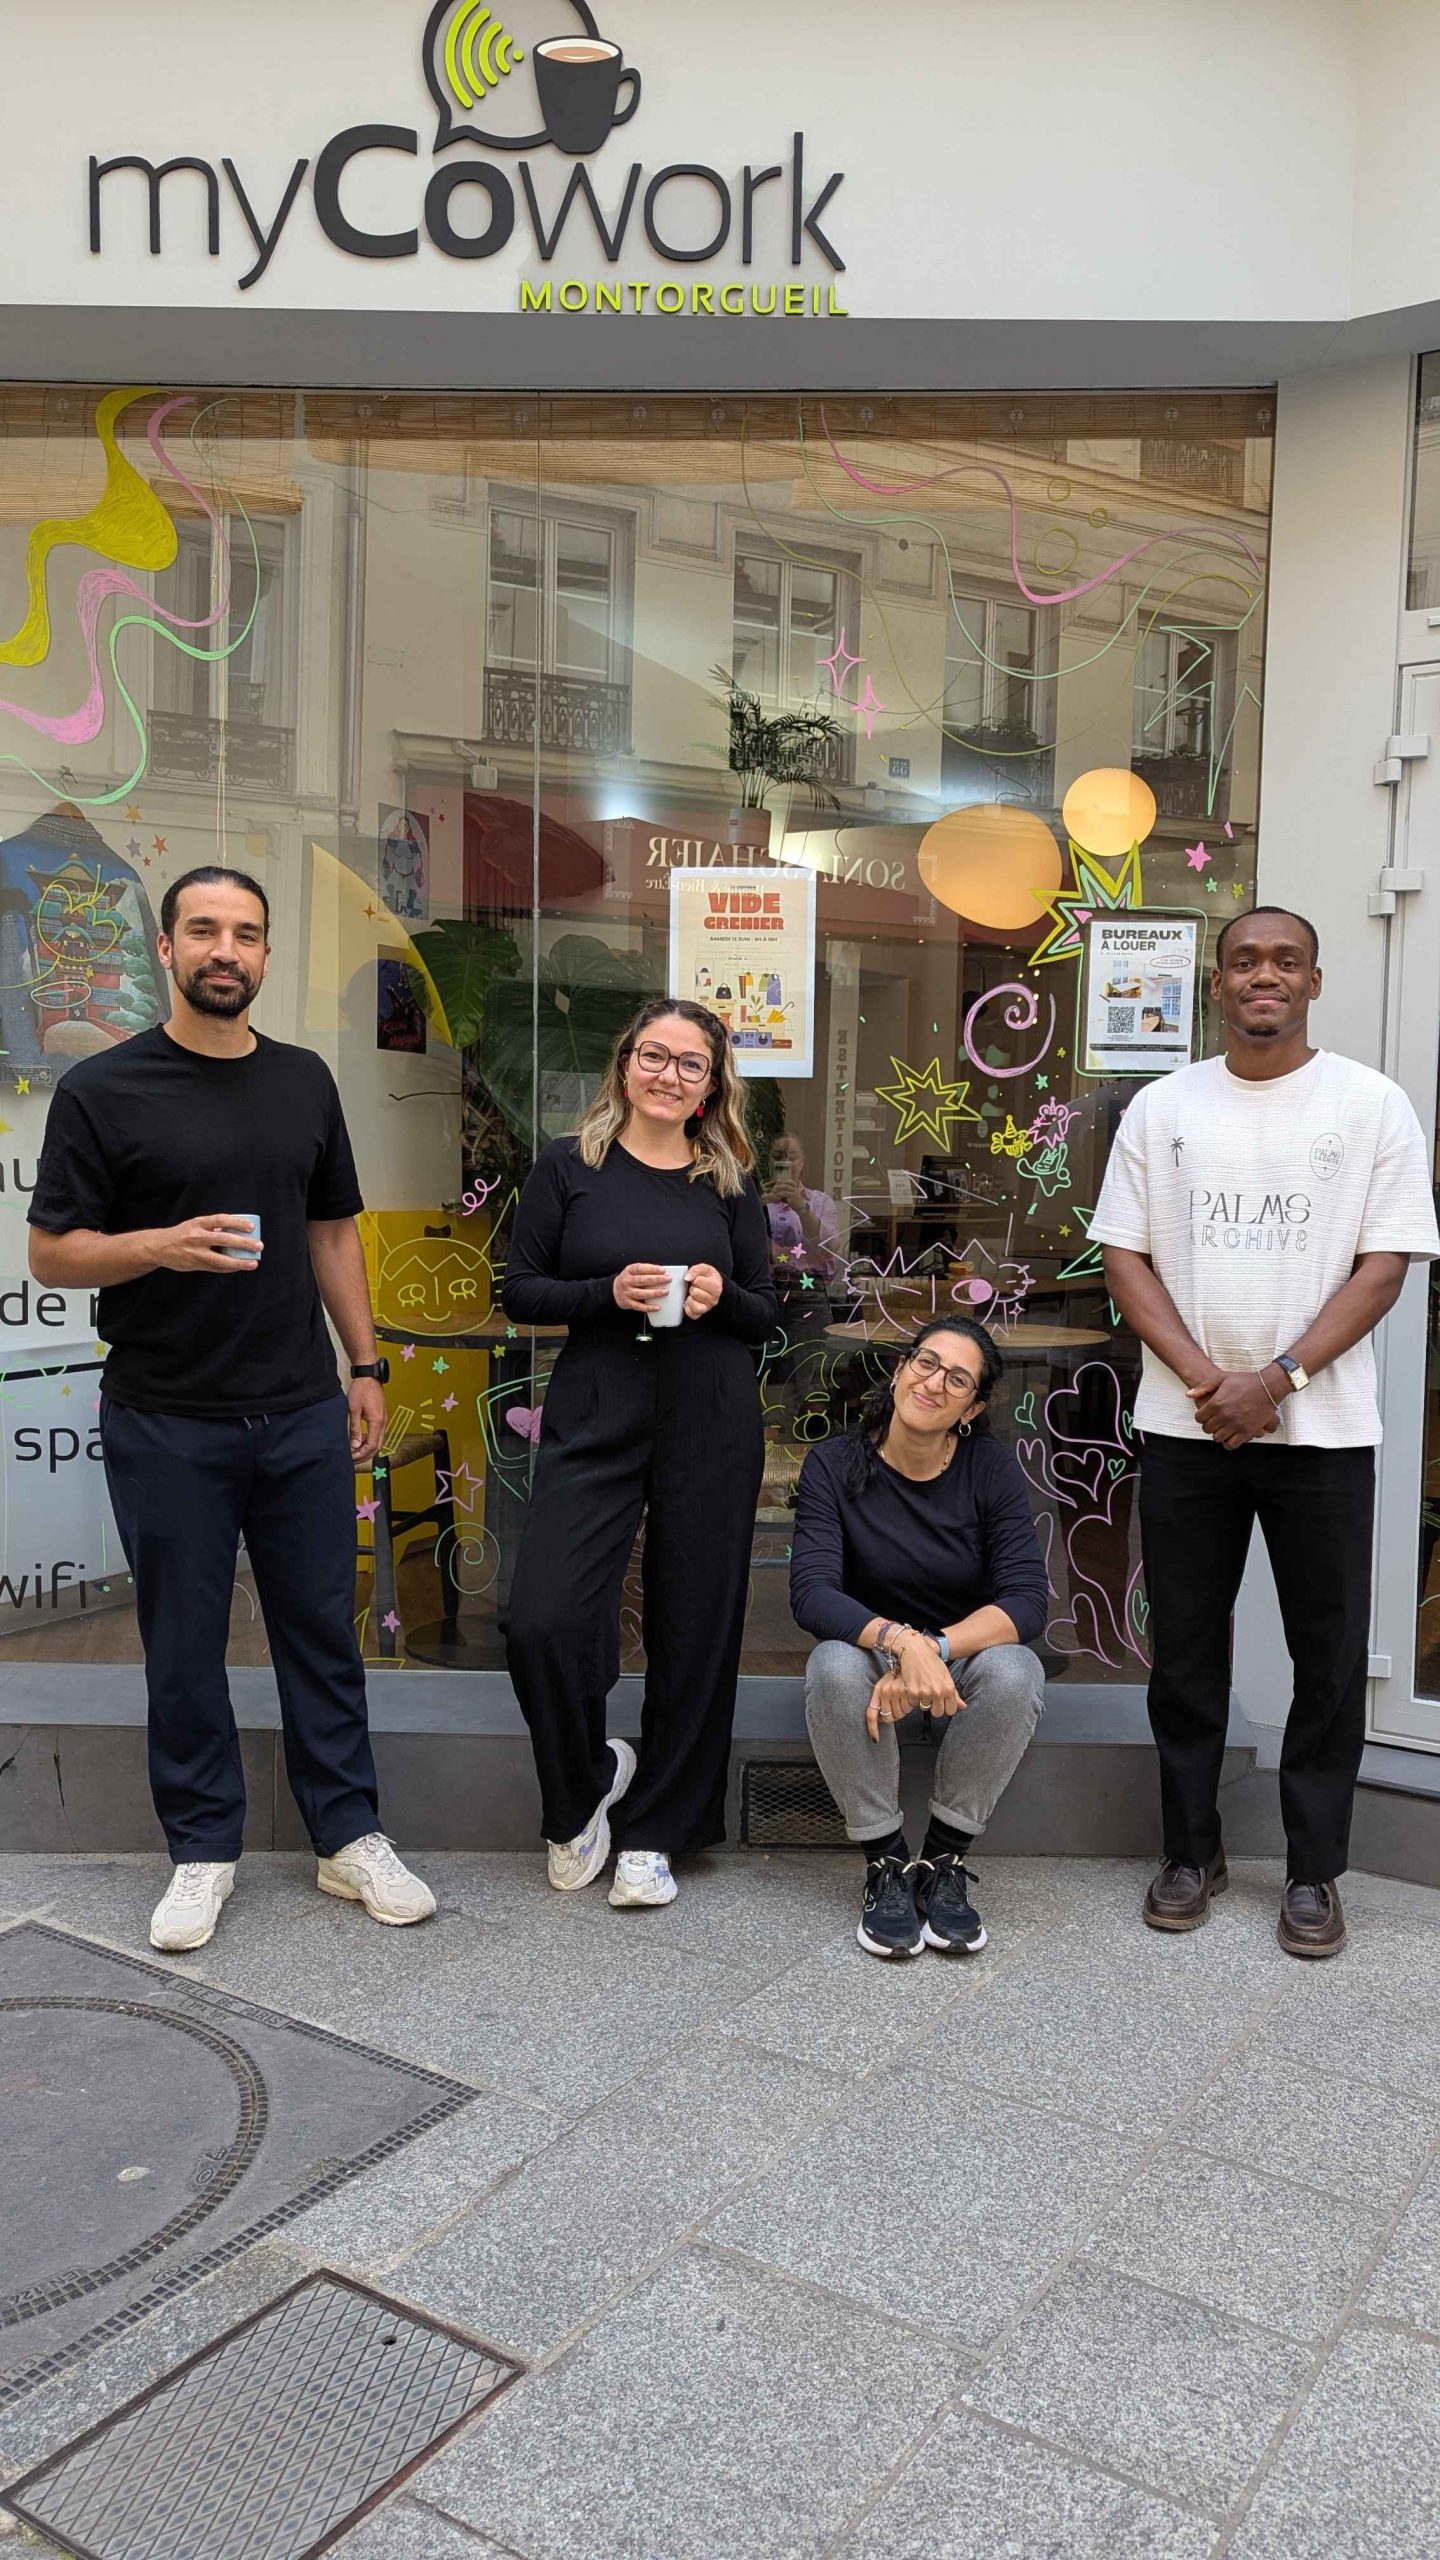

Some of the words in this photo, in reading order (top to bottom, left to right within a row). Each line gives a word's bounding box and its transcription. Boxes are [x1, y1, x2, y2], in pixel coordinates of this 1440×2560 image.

[520, 279, 849, 316] MONTORGUEIL
[707, 892, 781, 914] VIDE
[703, 916, 785, 931] GRENIER
[1101, 929, 1183, 941] BUREAUX
[1113, 940, 1157, 951] LOUER
[1189, 1190, 1312, 1225] PALMS
[0, 1280, 67, 1327] de
[240, 2006, 283, 2025] PARIS
